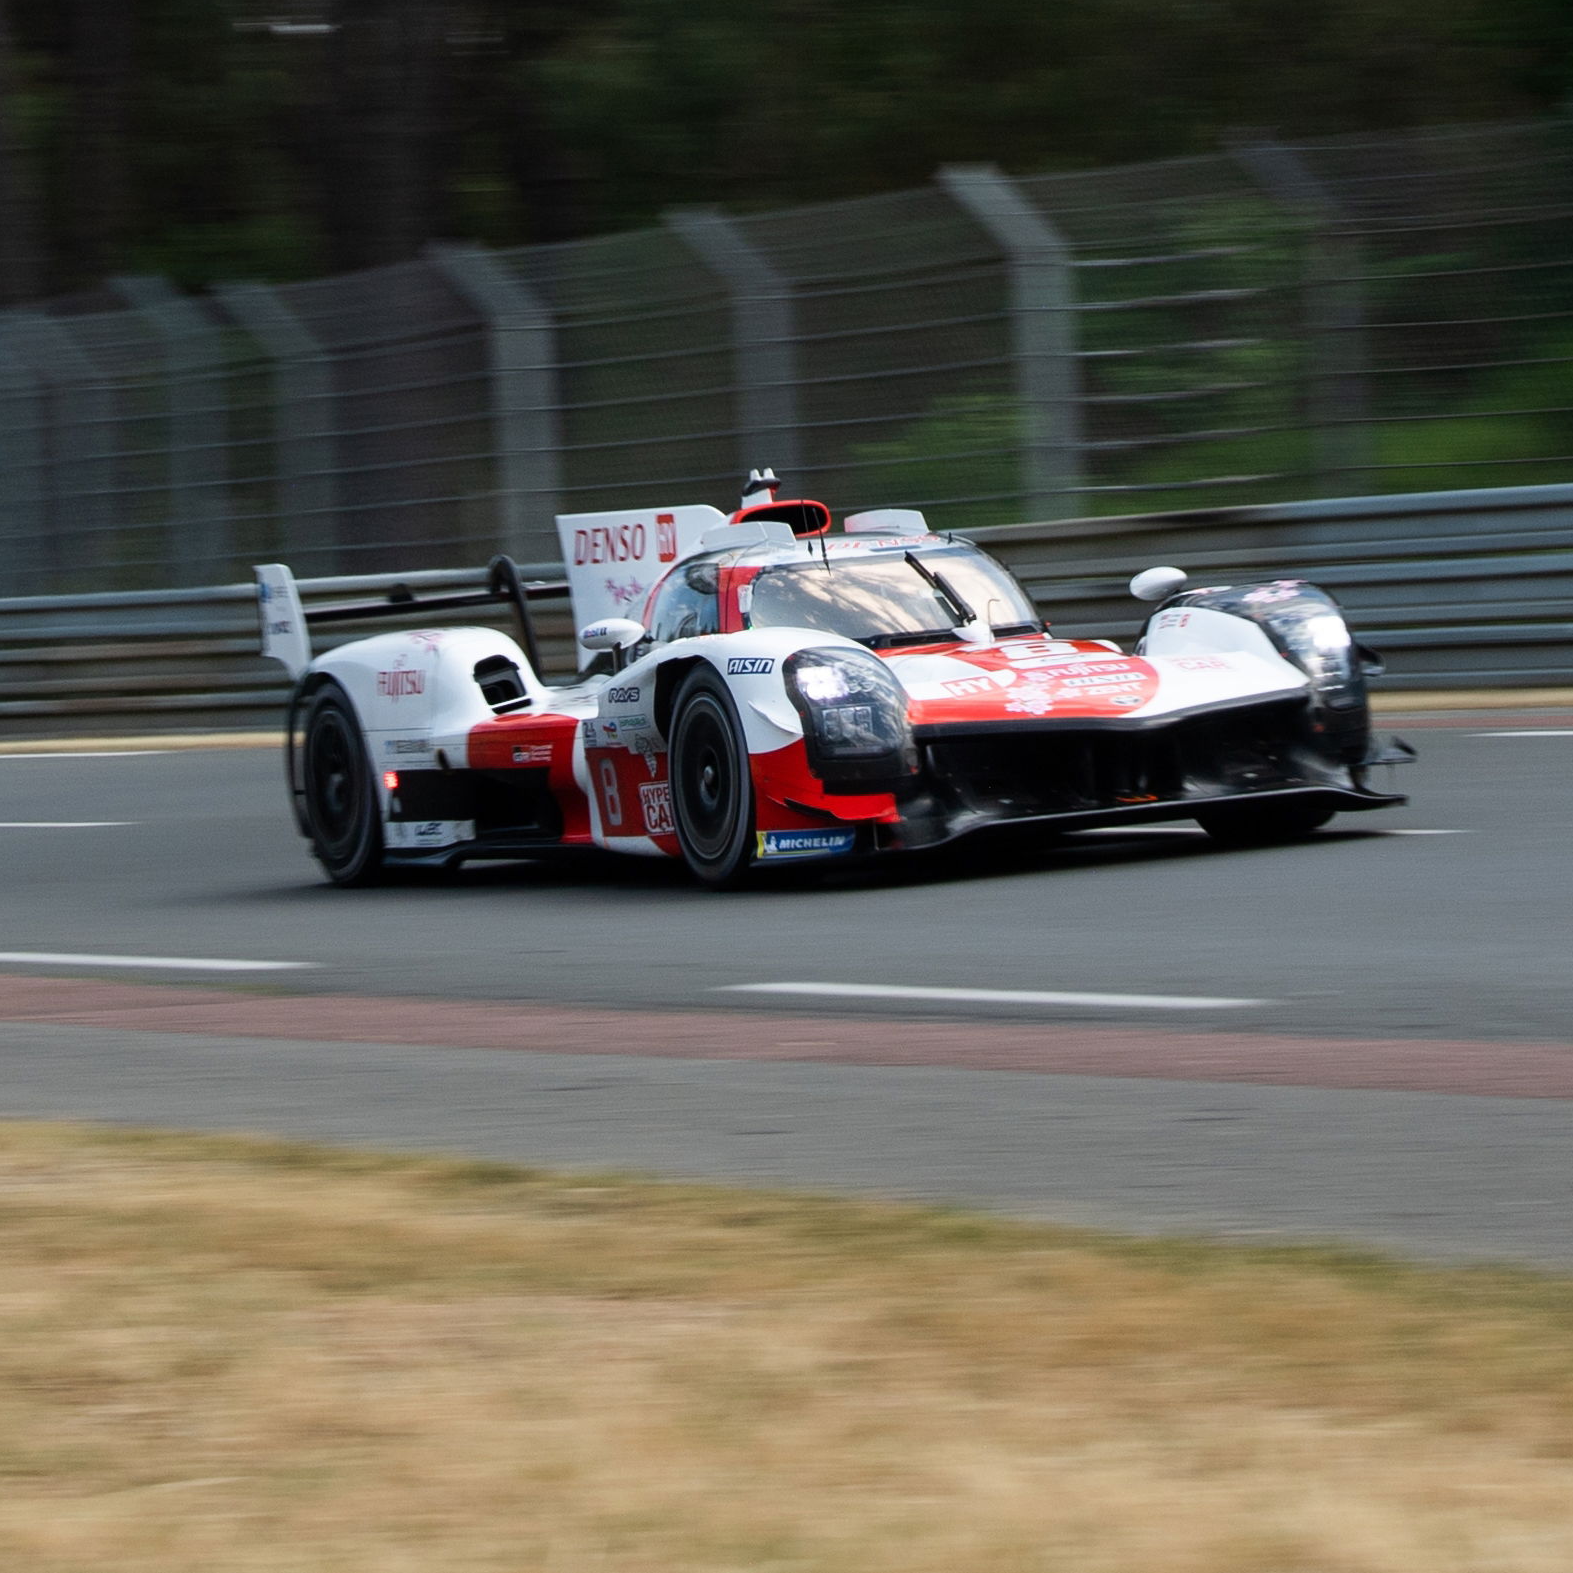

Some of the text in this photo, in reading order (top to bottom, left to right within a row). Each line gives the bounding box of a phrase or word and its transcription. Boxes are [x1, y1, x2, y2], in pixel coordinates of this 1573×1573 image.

[574, 523, 646, 566] DENSO
[729, 658, 774, 674] AISIN
[1050, 662, 1131, 680] FUJITSU
[378, 670, 426, 703] FUJITSU
[609, 687, 640, 703] RAYS
[601, 759, 623, 826] 8
[642, 787, 670, 804] HYPE
[779, 836, 846, 849] MICHELIN
